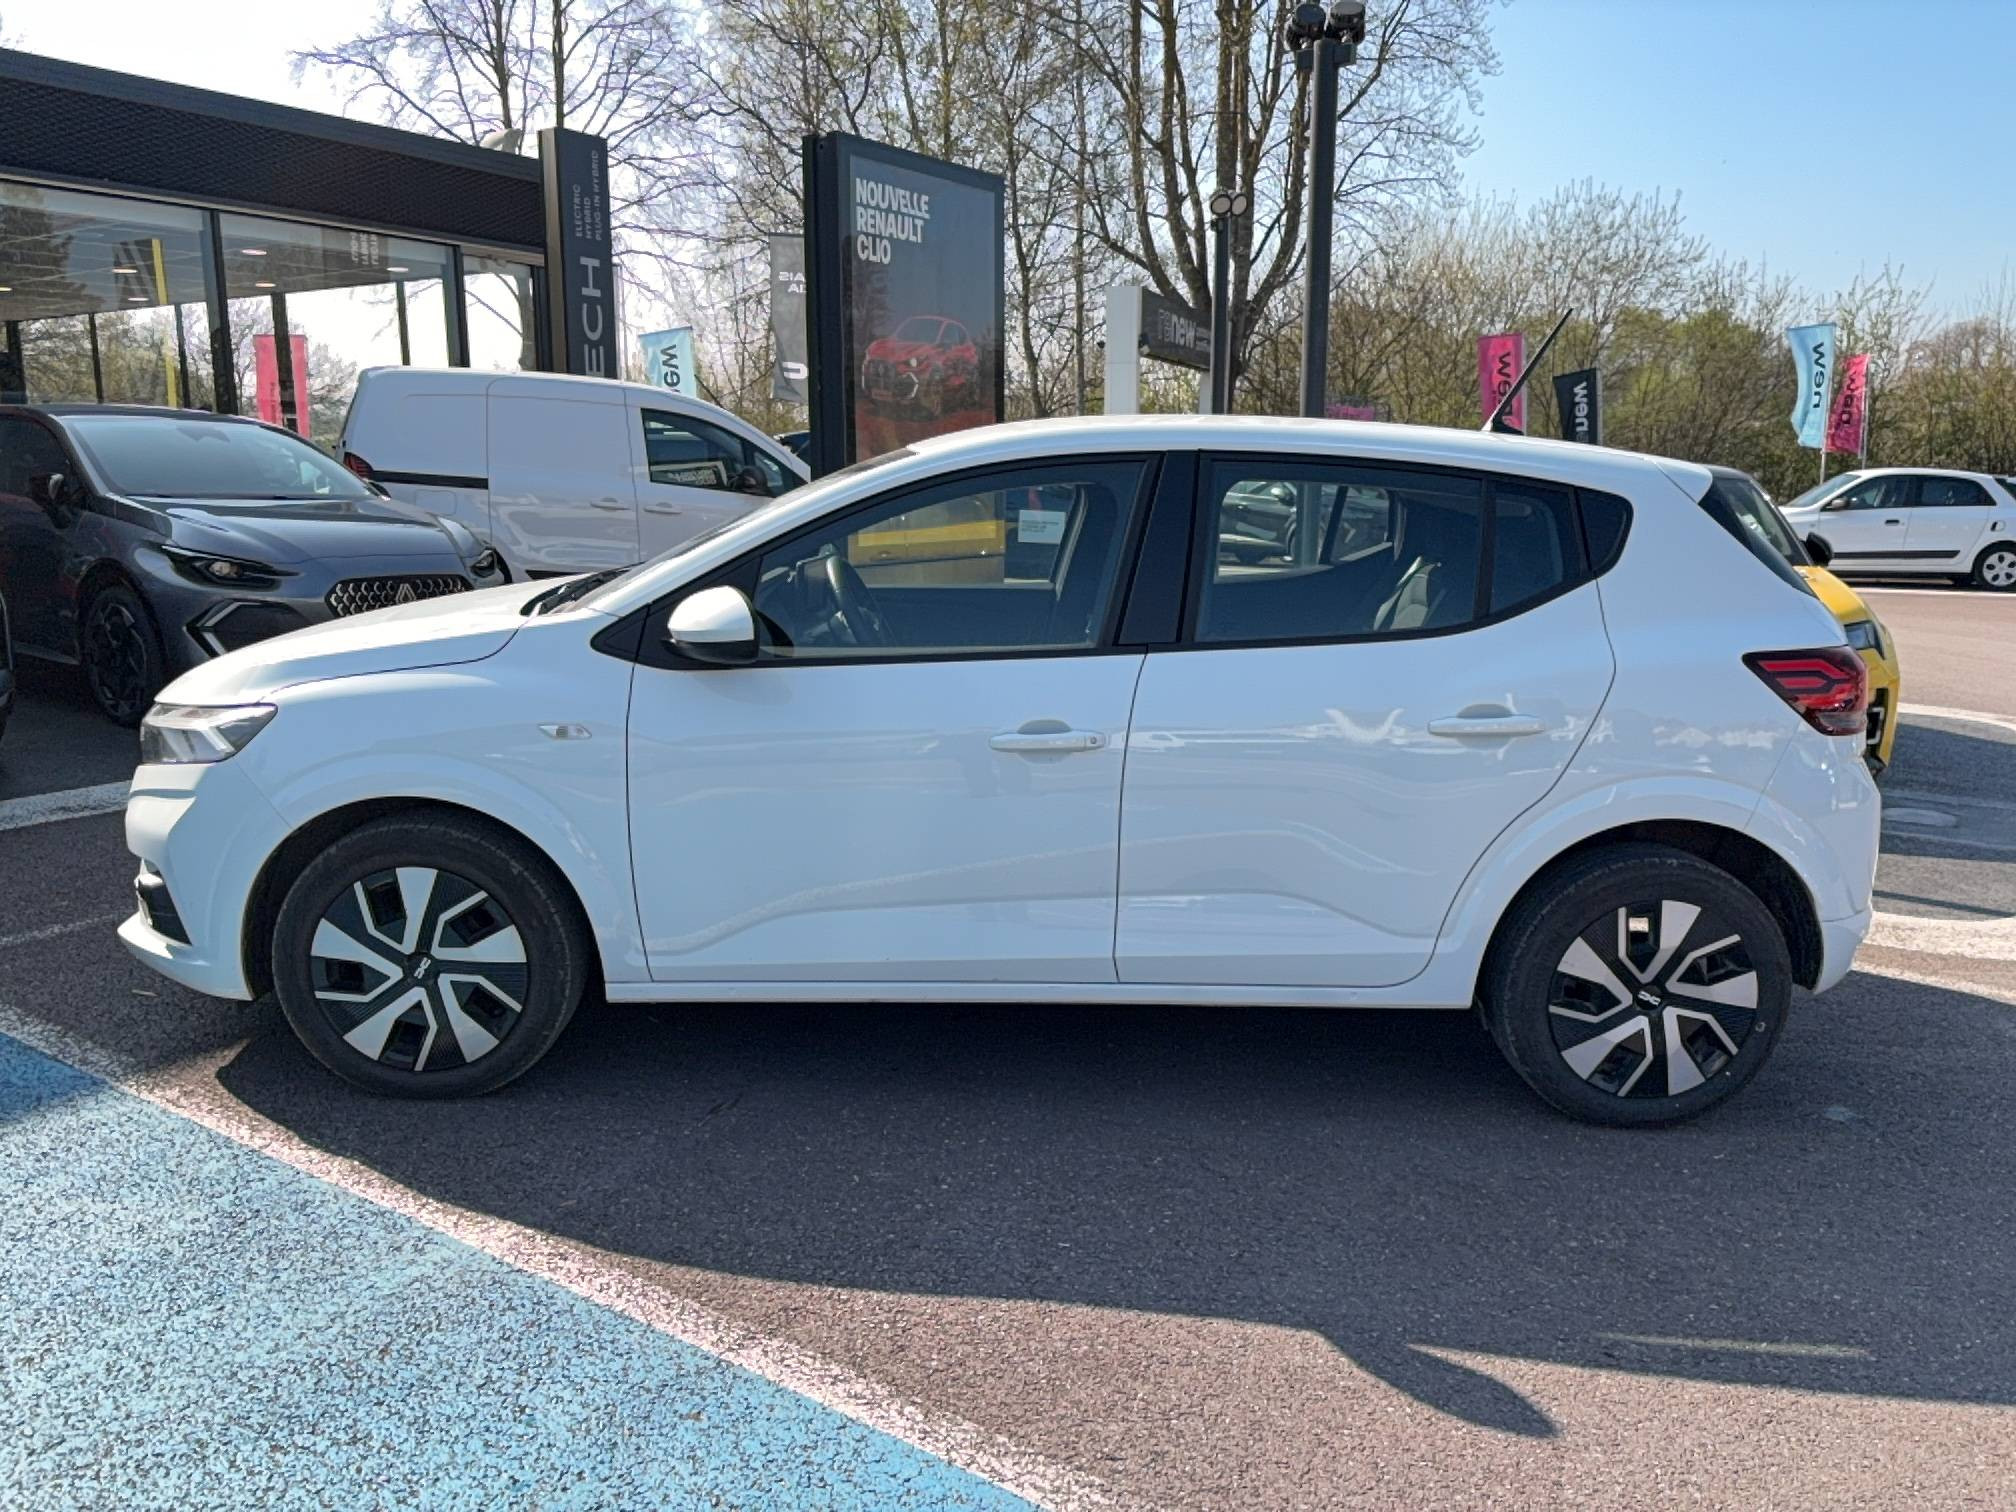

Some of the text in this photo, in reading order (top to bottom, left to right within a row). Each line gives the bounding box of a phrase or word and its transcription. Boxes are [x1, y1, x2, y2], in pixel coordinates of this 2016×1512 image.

[572, 183, 583, 237] ELECTRIC
[583, 196, 592, 239] HYBRID
[855, 177, 930, 220] NOUVELLE
[856, 206, 924, 243] RENAULT
[857, 234, 891, 265] CLIO
